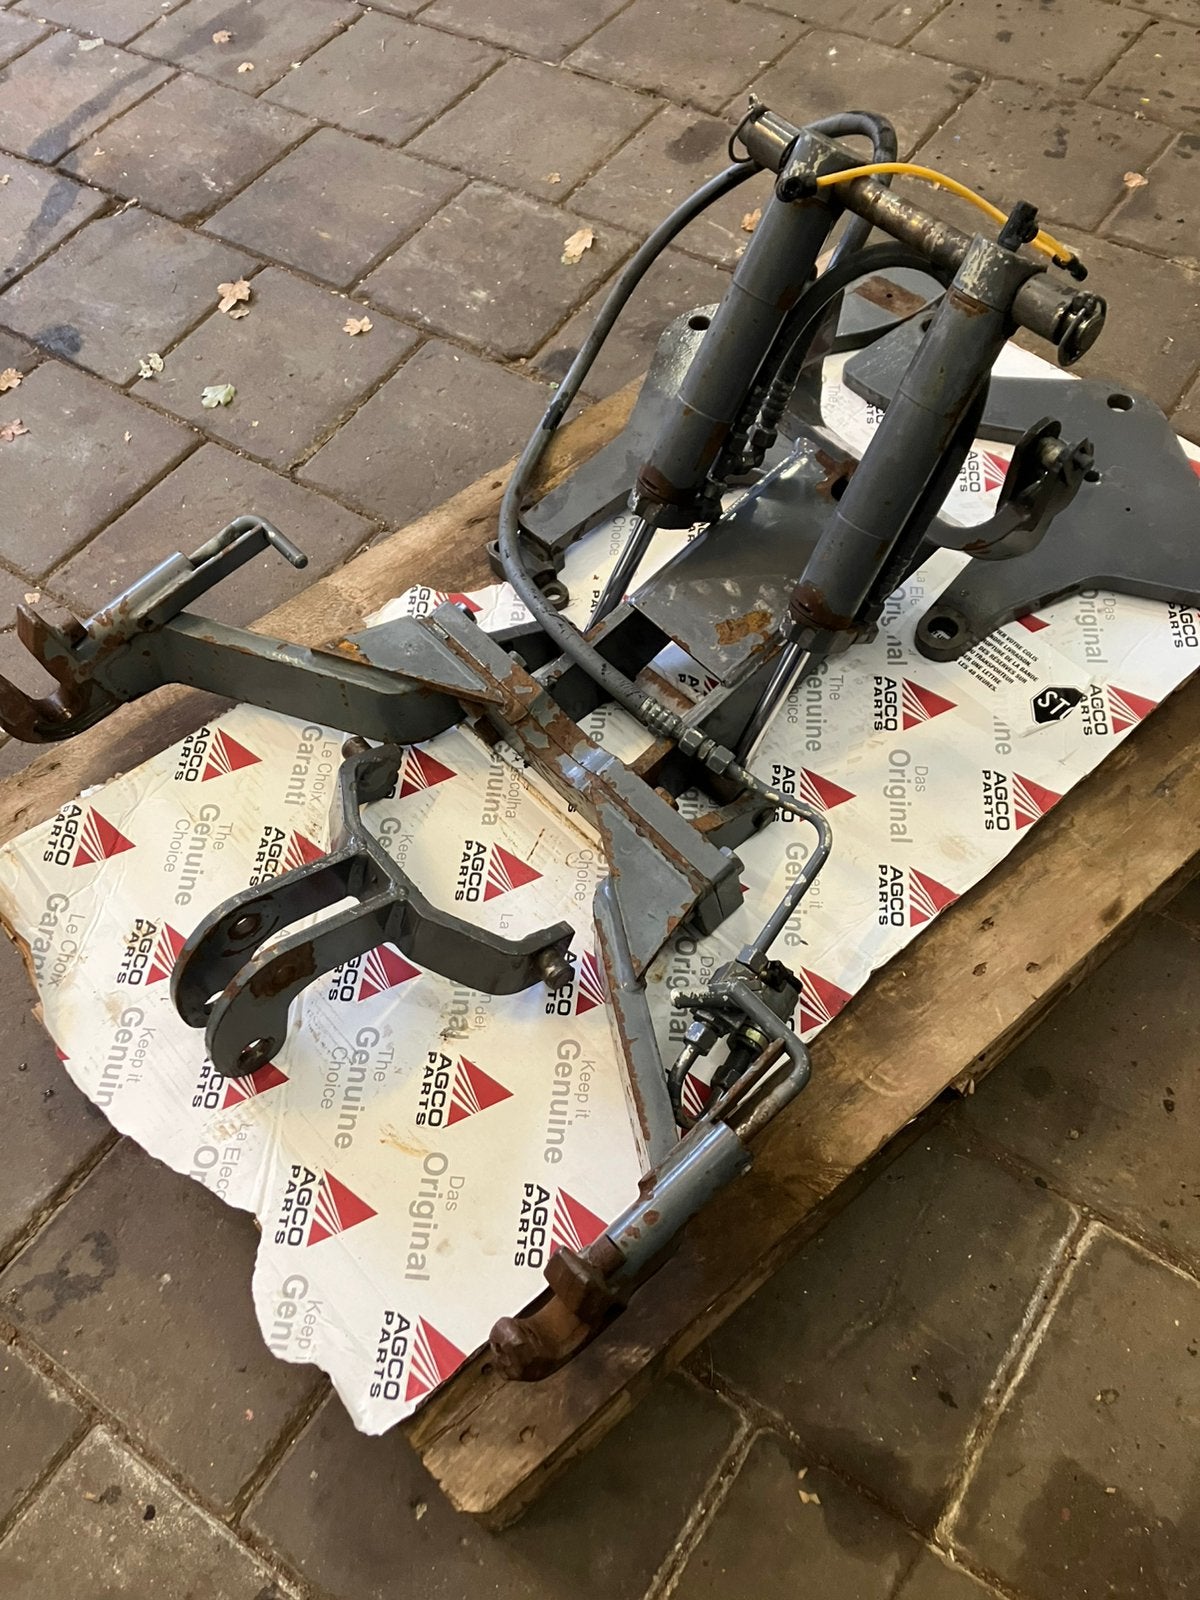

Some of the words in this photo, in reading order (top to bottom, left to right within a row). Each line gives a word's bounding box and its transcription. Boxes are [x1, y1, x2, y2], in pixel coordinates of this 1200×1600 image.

[959, 467, 968, 492] RTS
[968, 451, 981, 492] AGCO
[609, 516, 626, 556] Choice
[1102, 598, 1116, 621] Das
[1167, 601, 1184, 648] PARTS
[1178, 603, 1199, 648] AGCO
[829, 674, 844, 701] The
[874, 676, 883, 731] PARTS
[1090, 684, 1108, 736] AGCO
[1080, 694, 1093, 736] ARTS
[174, 735, 195, 781] ARTS
[185, 727, 211, 783] AGCO
[284, 725, 323, 807] Garanti
[321, 740, 338, 759] Le
[310, 761, 333, 803] Choix
[782, 765, 795, 822] AGO
[883, 749, 913, 843] Original
[914, 765, 929, 793] Das
[982, 769, 995, 830] PARTS
[993, 770, 1010, 831] AGCO
[54, 804, 82, 866] AGCO
[163, 819, 191, 873] Choice
[174, 803, 221, 907] Genuine
[212, 822, 234, 851] The
[249, 825, 273, 887] PARTS
[455, 840, 474, 901] PARTS
[466, 841, 488, 902] AGCO
[575, 849, 594, 902] Choice
[878, 864, 888, 926] PARTS
[890, 865, 904, 928] AGCO
[65, 913, 86, 934] Le
[500, 912, 514, 929] La
[116, 918, 145, 985] PARTS
[128, 920, 157, 986] AGCO
[340, 955, 361, 1001] GCO
[700, 956, 715, 985] Das
[129, 1027, 156, 1069] Keep
[373, 1047, 395, 1083] The
[126, 1074, 143, 1084] it
[204, 1074, 224, 1109] CO
[320, 1046, 348, 1109] Choice
[334, 1026, 381, 1149] Genuine
[416, 1051, 438, 1126] PARTS
[428, 1053, 452, 1127] AGCO
[543, 1039, 581, 1164] Genuine
[574, 1059, 596, 1104] Keep
[575, 1111, 590, 1119] it
[274, 1164, 302, 1245] PARTS
[287, 1166, 316, 1247] AGCO
[404, 1152, 449, 1281] Original
[445, 1175, 465, 1211] Das
[514, 1183, 534, 1267] PARTS
[527, 1184, 551, 1269] AGCO
[295, 1300, 324, 1350] Keep
[370, 1310, 395, 1398] PARTS
[383, 1313, 411, 1400] AGCO
